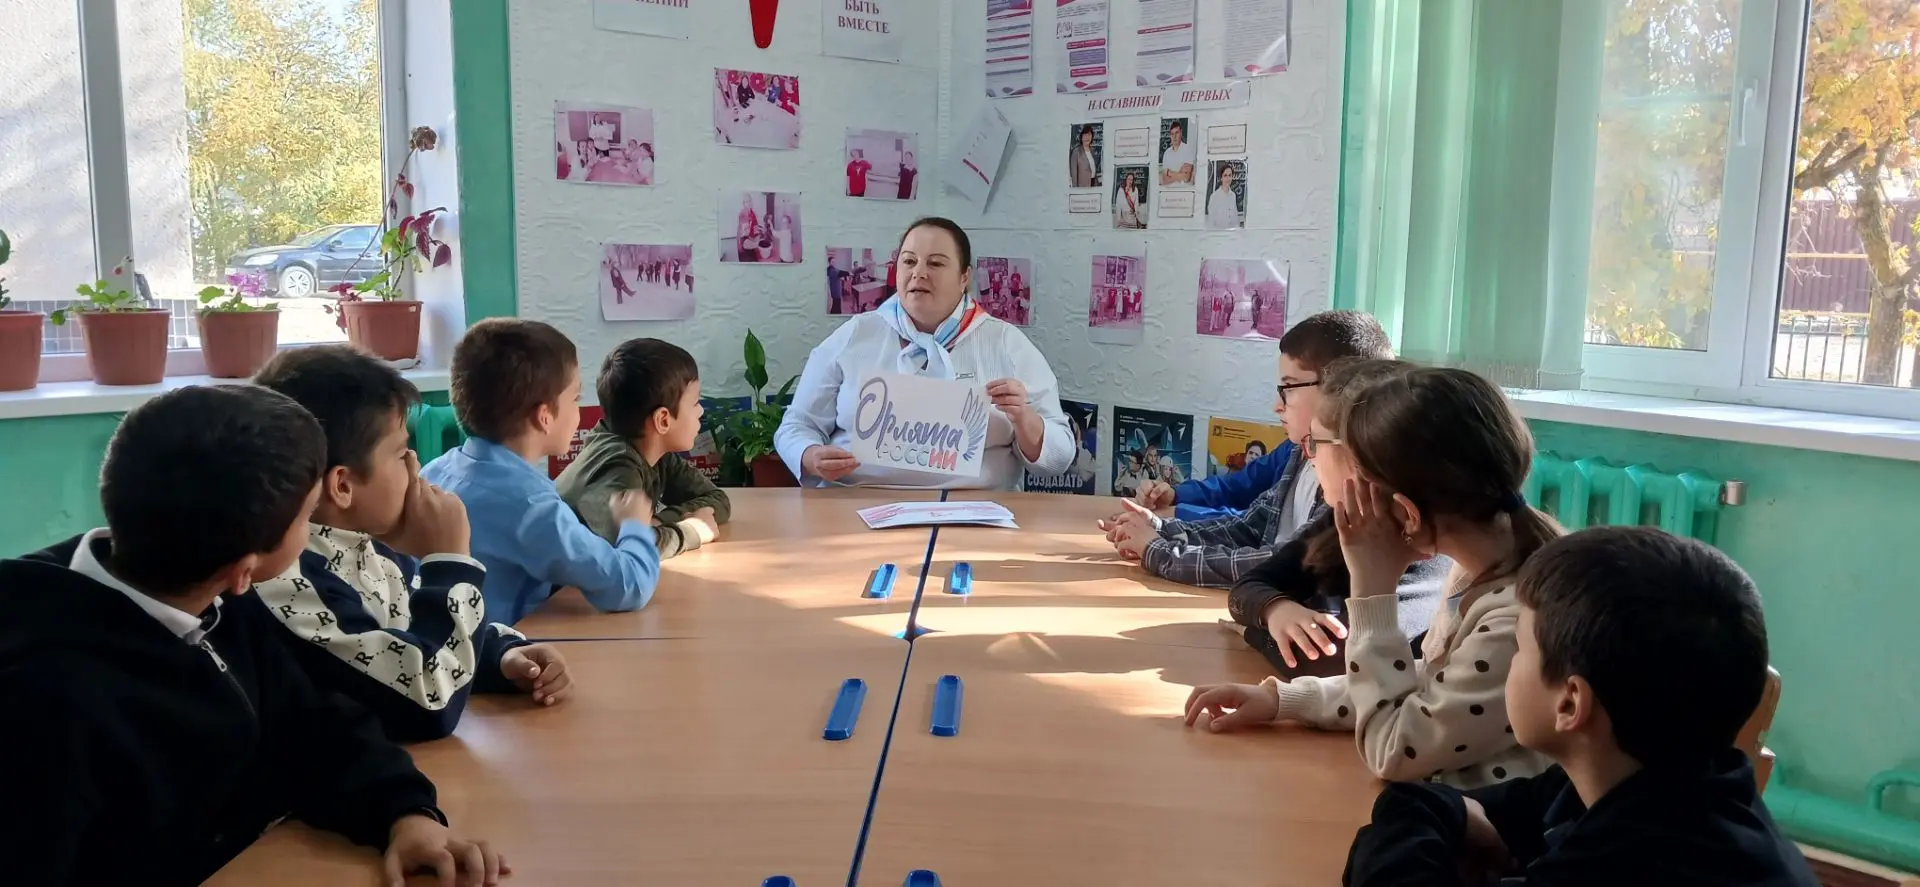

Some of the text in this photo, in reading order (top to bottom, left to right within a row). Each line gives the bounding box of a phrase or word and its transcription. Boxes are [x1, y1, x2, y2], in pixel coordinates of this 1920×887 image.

[845, 0, 879, 14] БЫТЬ
[838, 15, 890, 33] ВМЕСТЕ
[1087, 89, 1232, 111] НАСТАВНИКИ ПЕРВЫХ
[855, 376, 963, 452] Орлята
[1027, 474, 1083, 488] СОЗДАВАТЬ
[292, 578, 309, 592] R
[280, 605, 297, 619] R
[388, 603, 402, 618] R
[316, 611, 335, 626] R
[388, 640, 406, 656] R
[355, 652, 374, 667] R
[397, 672, 413, 689] R
